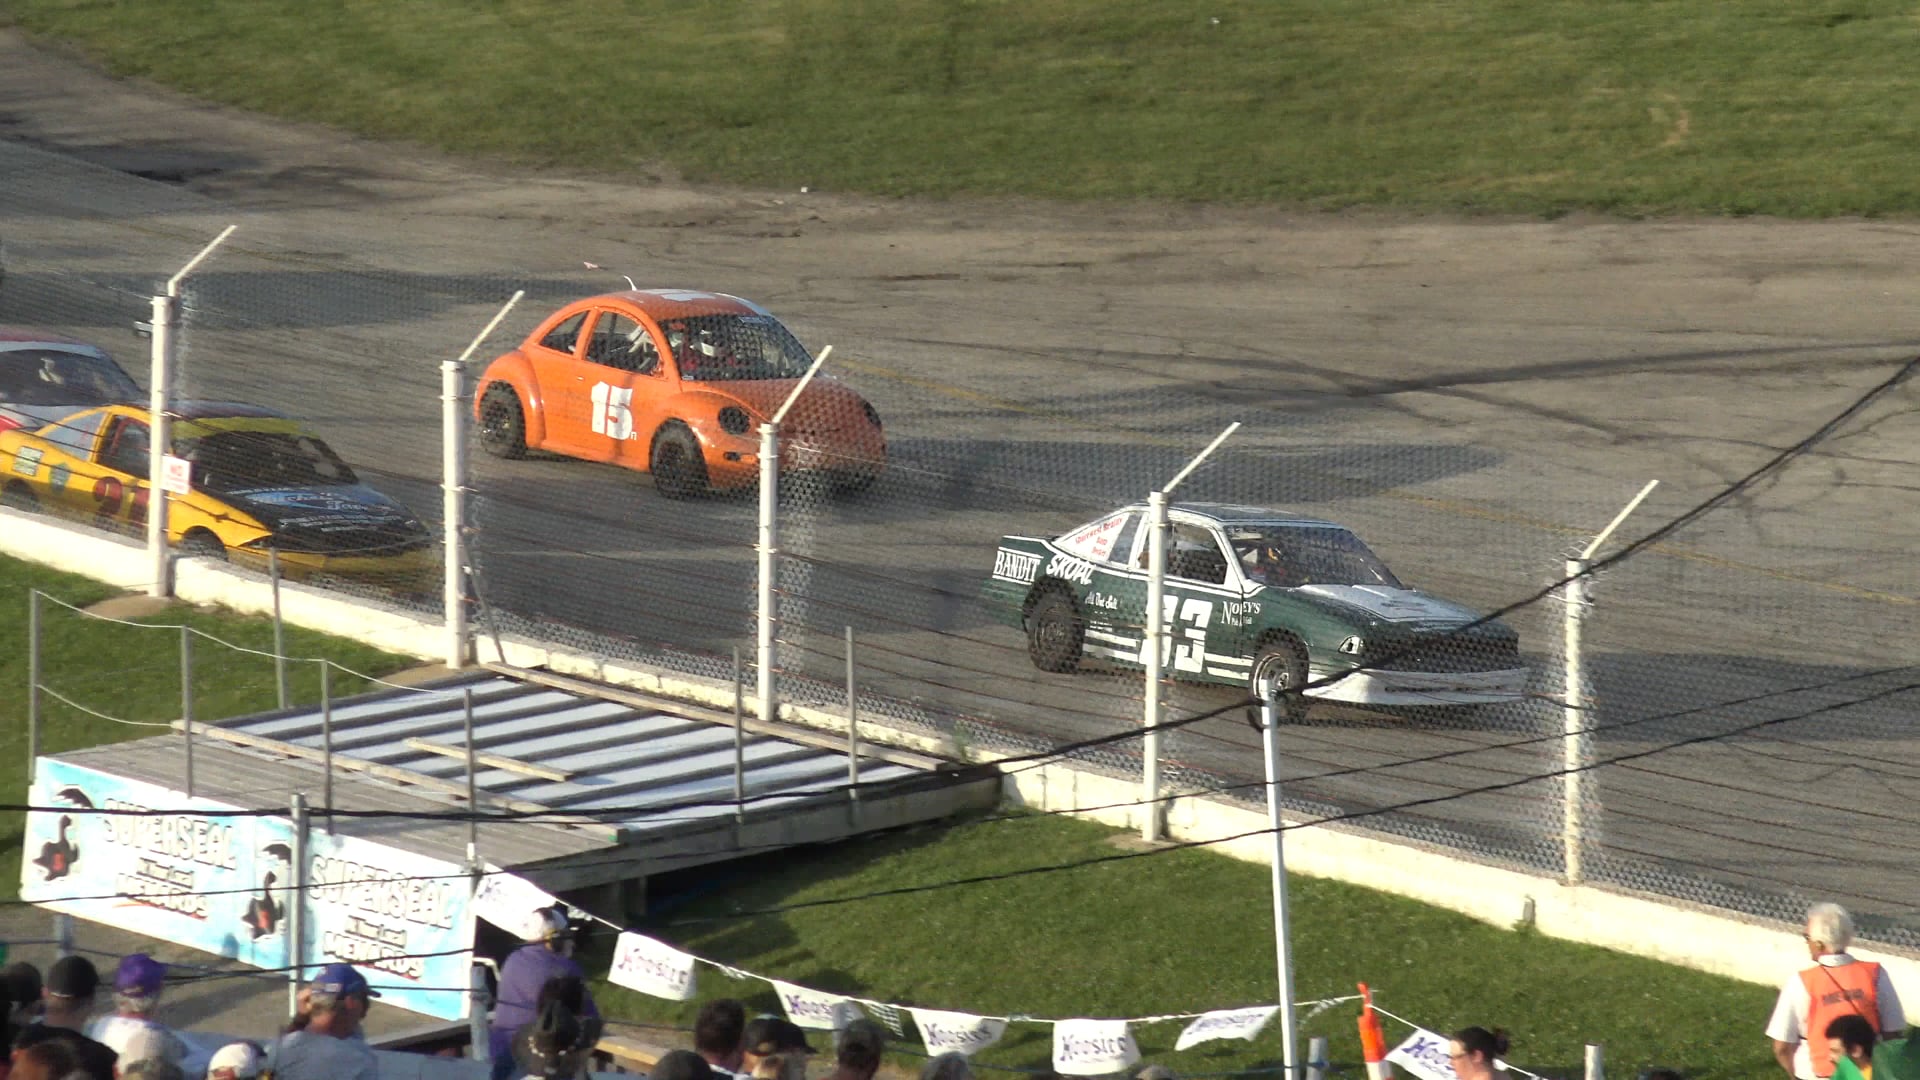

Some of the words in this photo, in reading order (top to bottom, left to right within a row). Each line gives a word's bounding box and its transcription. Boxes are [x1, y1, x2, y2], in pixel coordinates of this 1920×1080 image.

[591, 380, 633, 440] 15
[993, 550, 1041, 582] BANDIT
[1046, 554, 1096, 585] SKOAL
[103, 798, 236, 871] SUPERSEAL
[115, 872, 208, 919] MENARDS
[309, 854, 453, 930] SUPERSEAL
[323, 931, 423, 979] MENARDS
[1059, 1032, 1129, 1063] Hoosier
